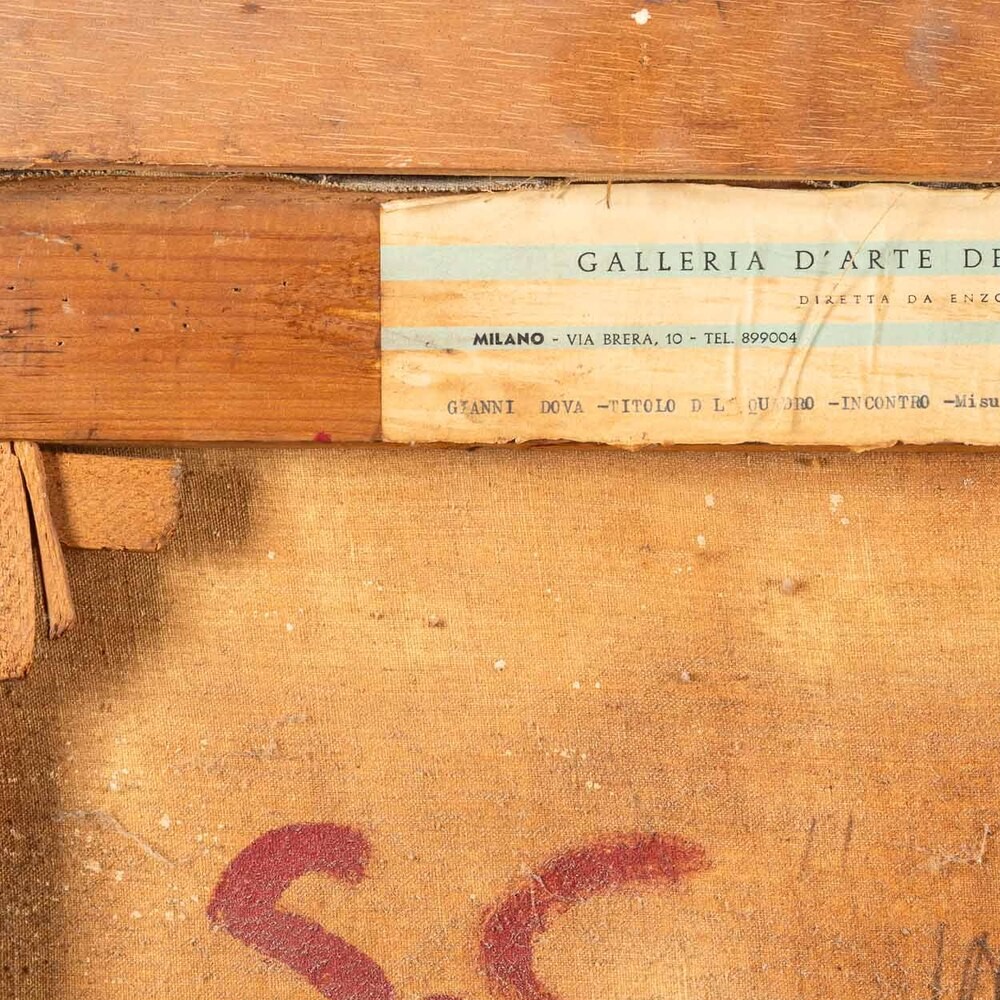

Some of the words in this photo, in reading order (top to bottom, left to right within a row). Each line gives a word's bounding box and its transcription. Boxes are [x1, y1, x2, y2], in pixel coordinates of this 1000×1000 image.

[577, 250, 766, 273] GALLERIA
[794, 248, 933, 271] D'ARTE
[799, 294, 891, 306] DIRETTA
[907, 293, 933, 304] DA
[472, 332, 545, 346] MILANO
[566, 333, 595, 346] VIA
[603, 332, 659, 347] BRERA,
[666, 332, 683, 345] 10
[703, 332, 735, 346] TEL.
[741, 331, 798, 344] 899004
[540, 399, 584, 415] DOVA
